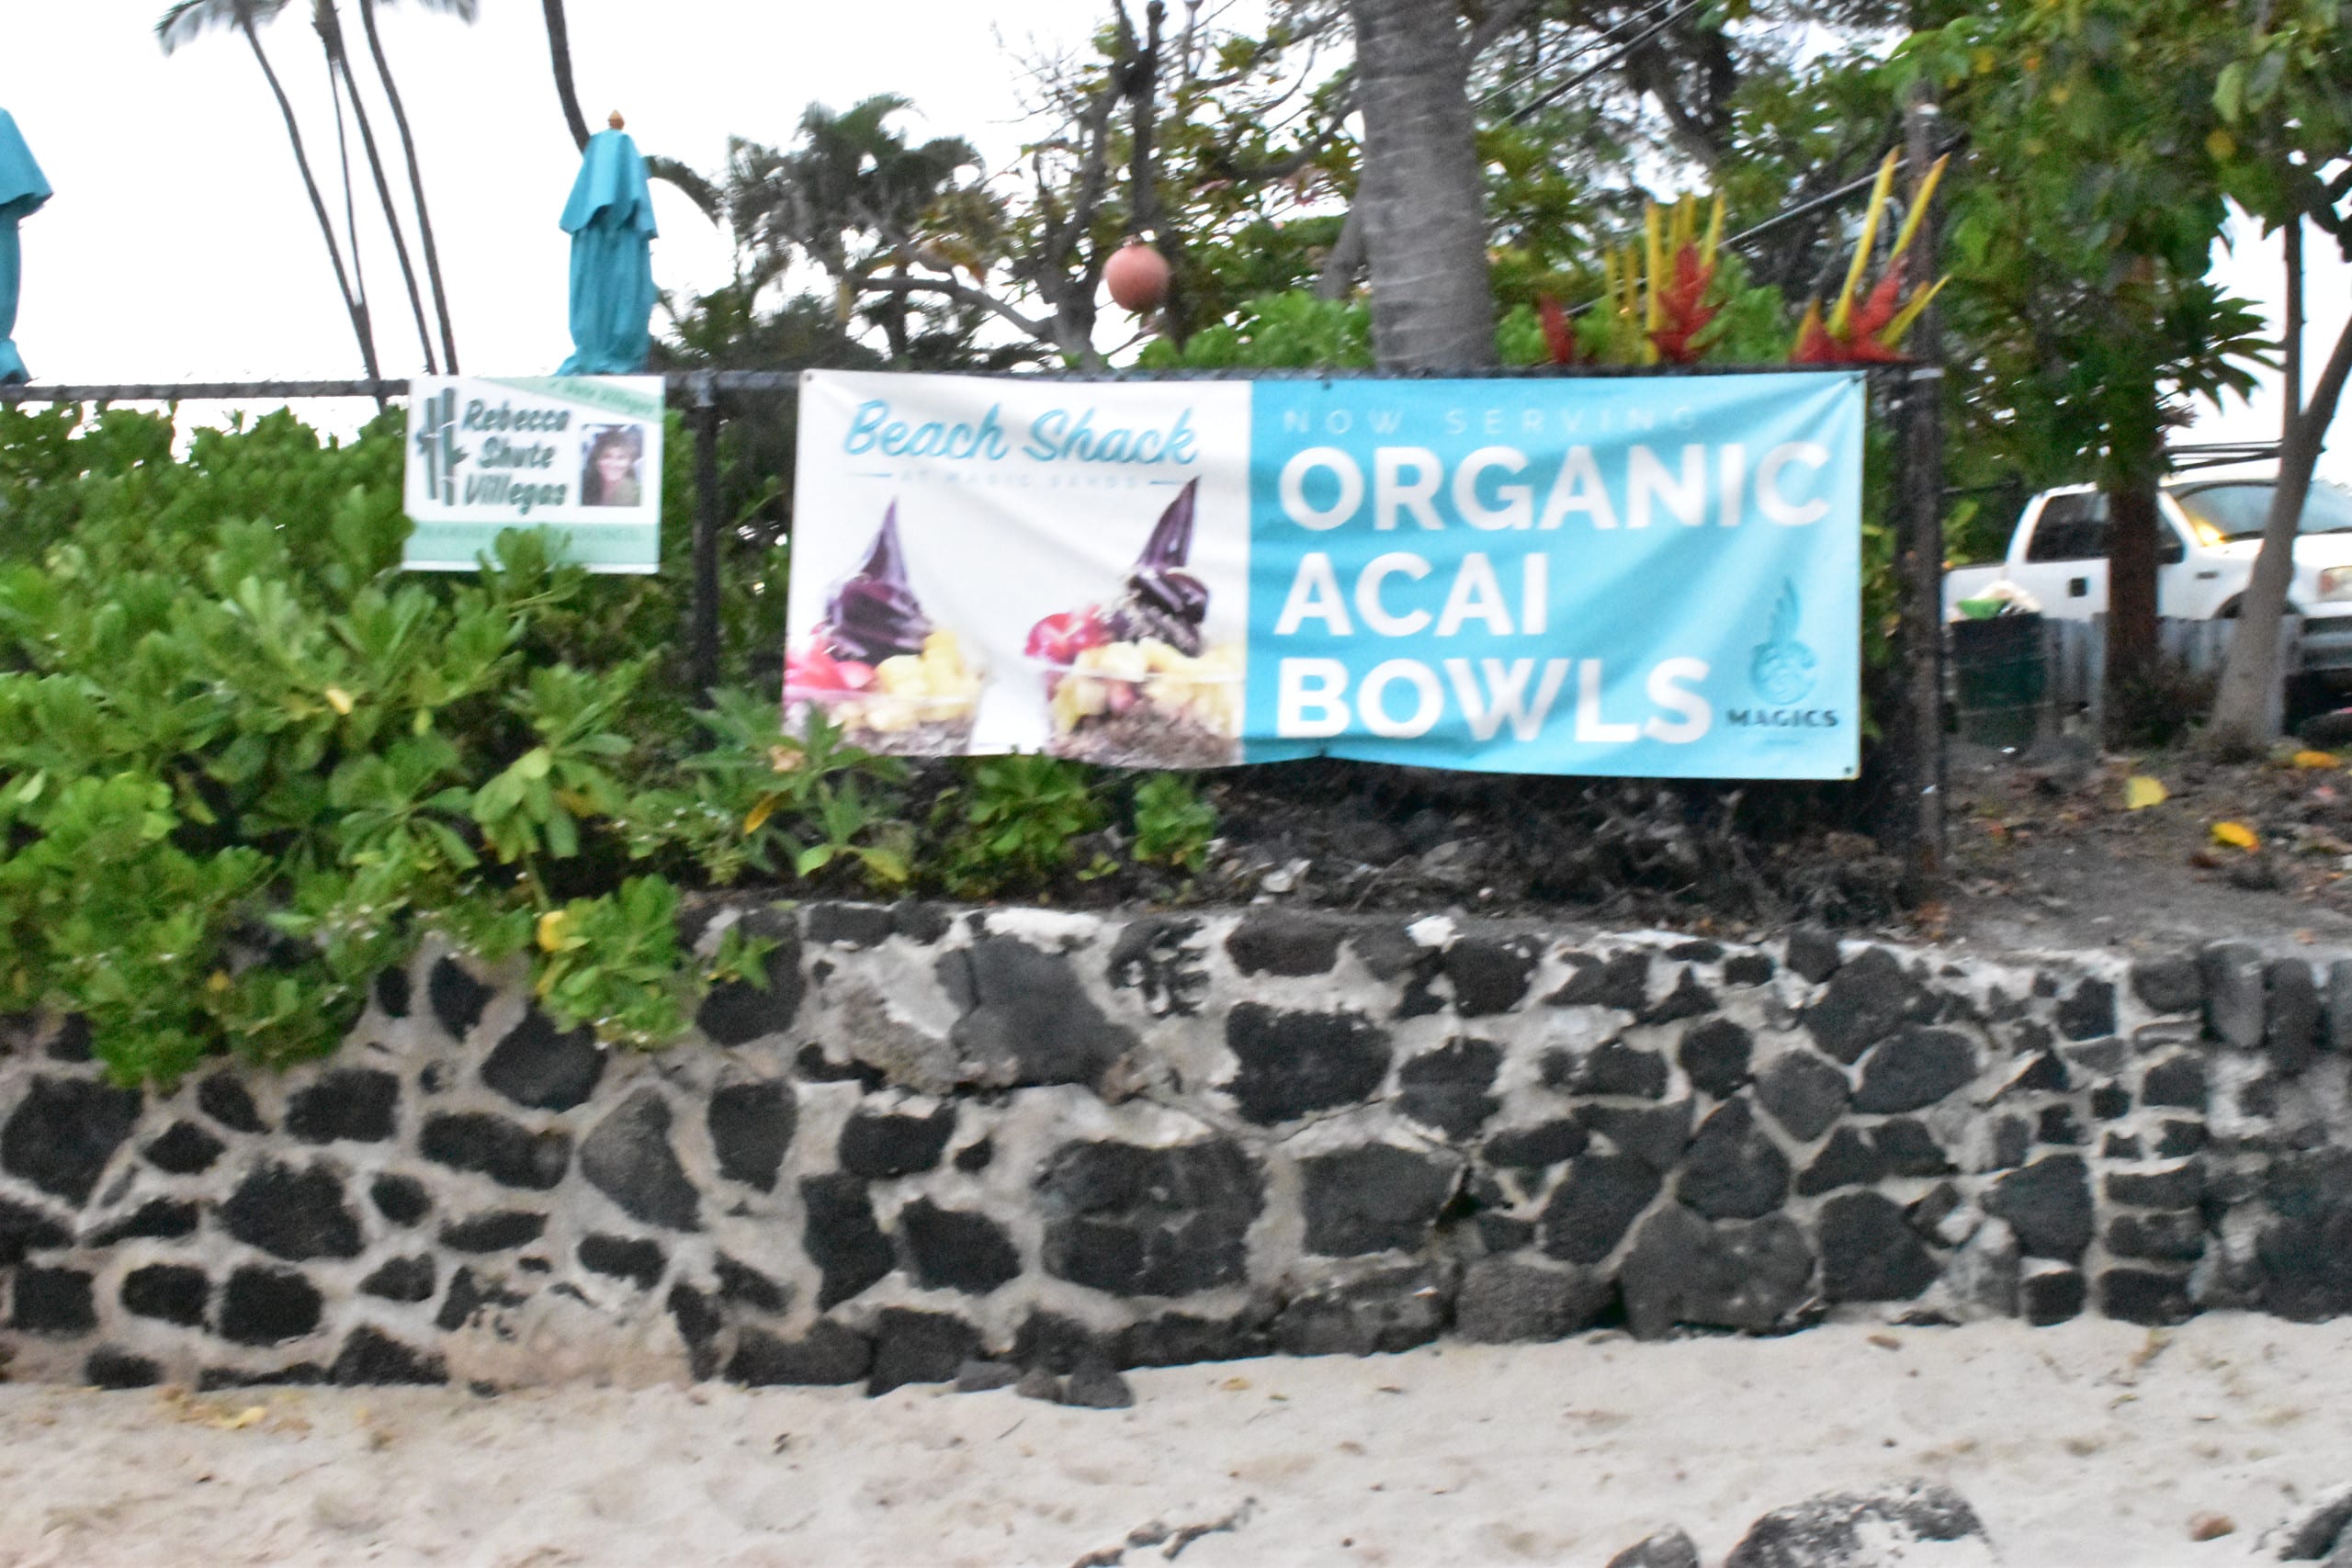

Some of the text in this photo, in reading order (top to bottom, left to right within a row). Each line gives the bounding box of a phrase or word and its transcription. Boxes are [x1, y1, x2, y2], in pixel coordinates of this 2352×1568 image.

[462, 399, 571, 432] Rebecca
[844, 399, 1201, 465] Beach Shack
[1283, 407, 1697, 435] NOW SERVING
[463, 472, 570, 516] Villegas
[1278, 440, 1831, 532] ORGANIC
[1273, 551, 1547, 637] ACAI
[1277, 656, 1713, 744] BOWLS
[1725, 707, 1840, 728] MAGICS
